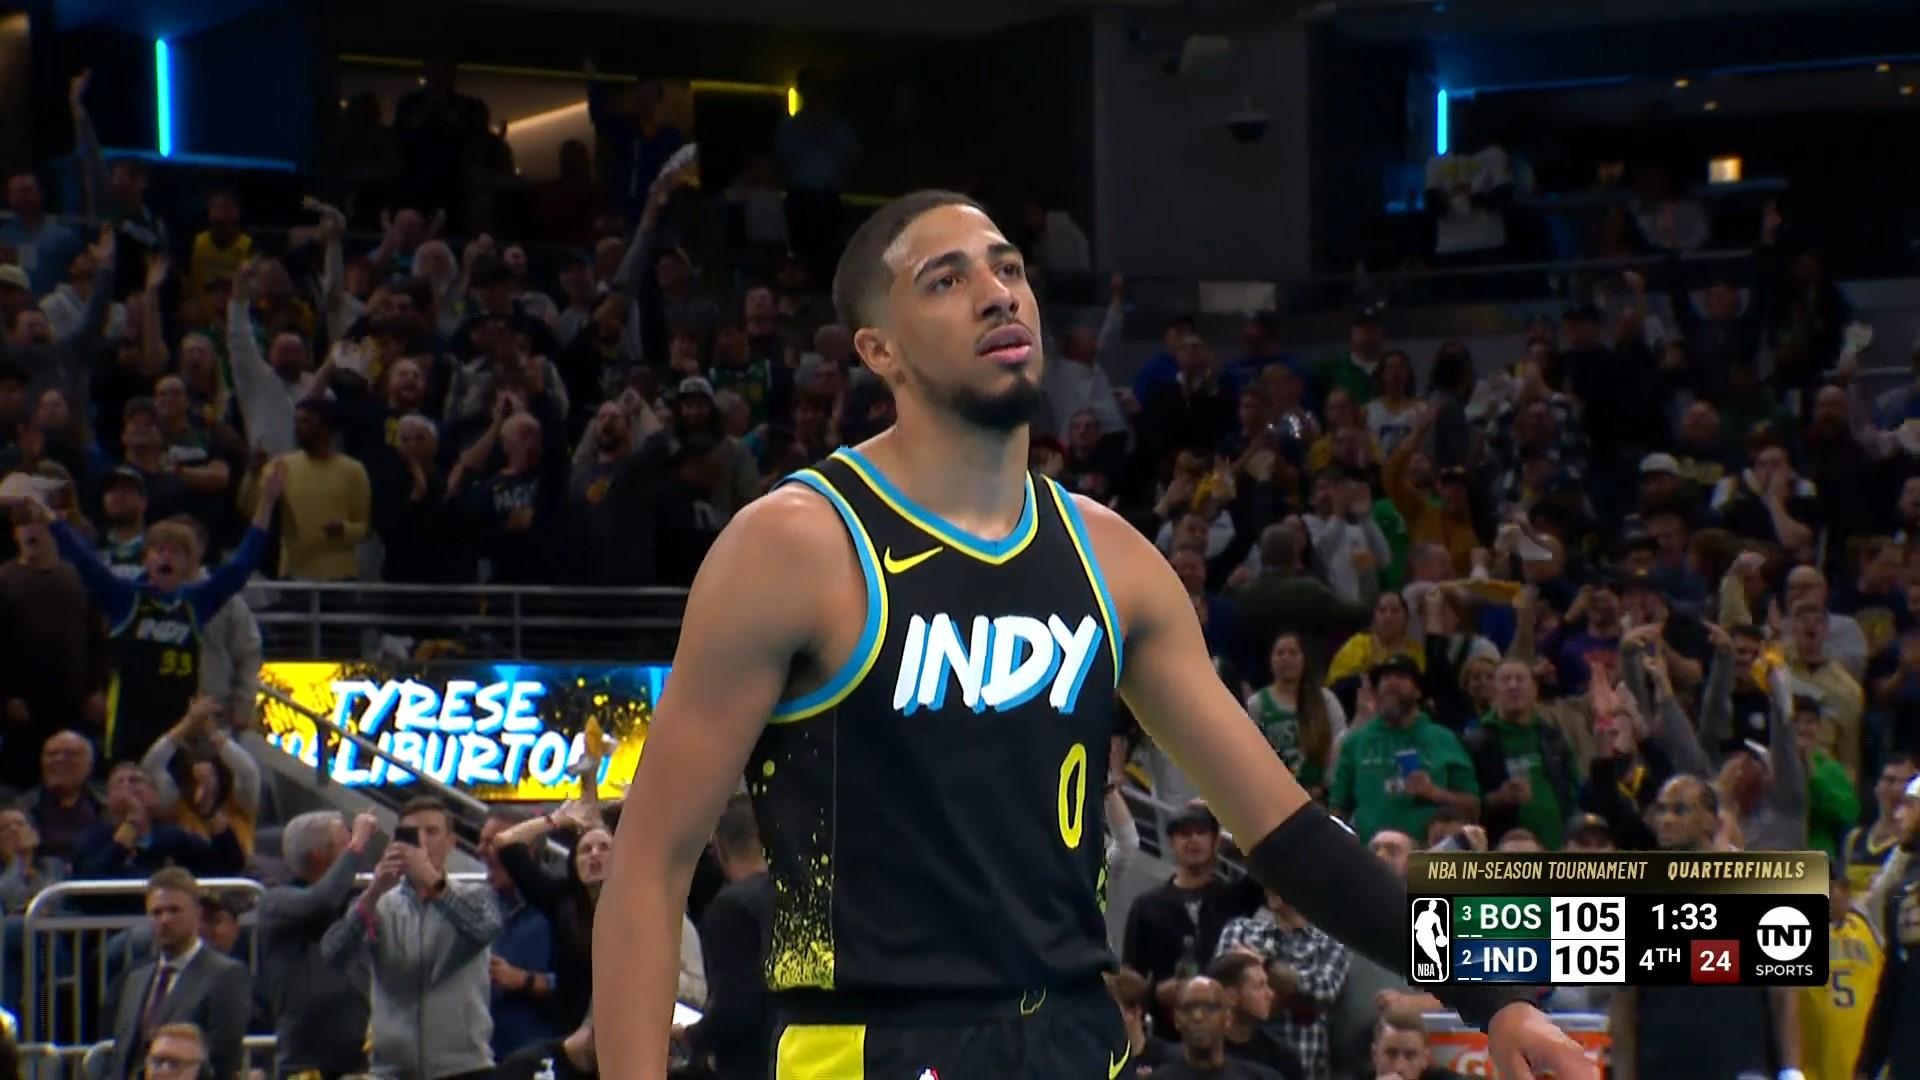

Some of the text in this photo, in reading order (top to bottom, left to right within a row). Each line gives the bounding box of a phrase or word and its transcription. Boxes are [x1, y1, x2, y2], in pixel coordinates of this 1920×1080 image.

[331, 678, 546, 736] TYRESE
[893, 612, 1104, 717] INDY
[1057, 741, 1088, 850] 0
